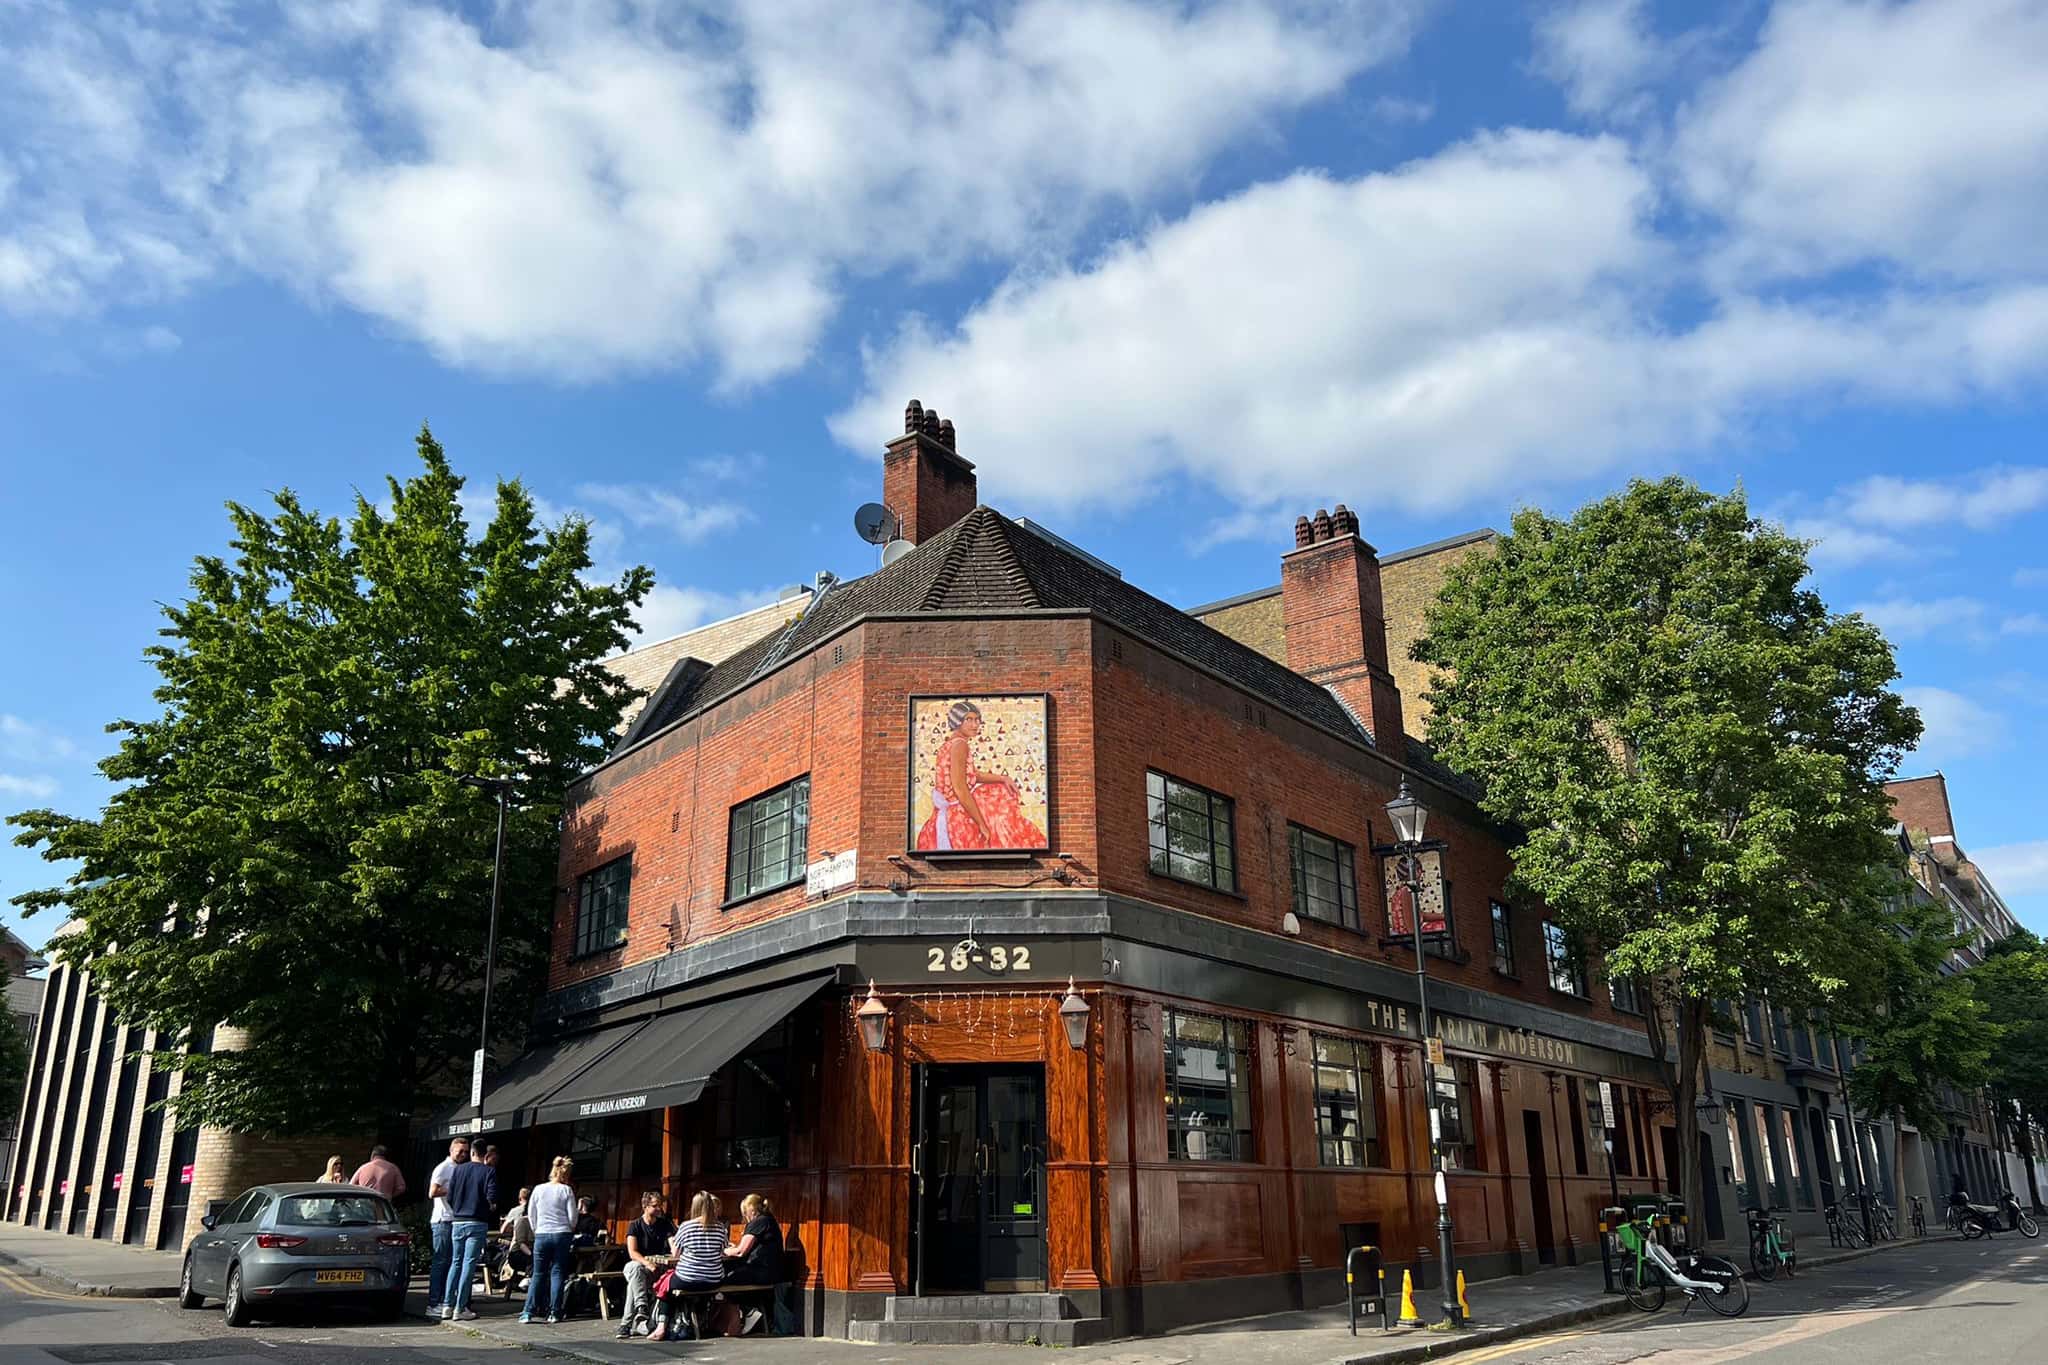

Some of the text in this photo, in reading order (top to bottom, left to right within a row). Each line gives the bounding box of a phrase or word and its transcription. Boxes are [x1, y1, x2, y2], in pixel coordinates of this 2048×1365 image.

[809, 859, 854, 880] NORTHAMPTON
[927, 946, 1032, 972] 28-32
[1367, 1001, 1408, 1032] THE
[1498, 1029, 1574, 1065] ANDERSON
[580, 1094, 648, 1116] THE MARIAN ANDERSON
